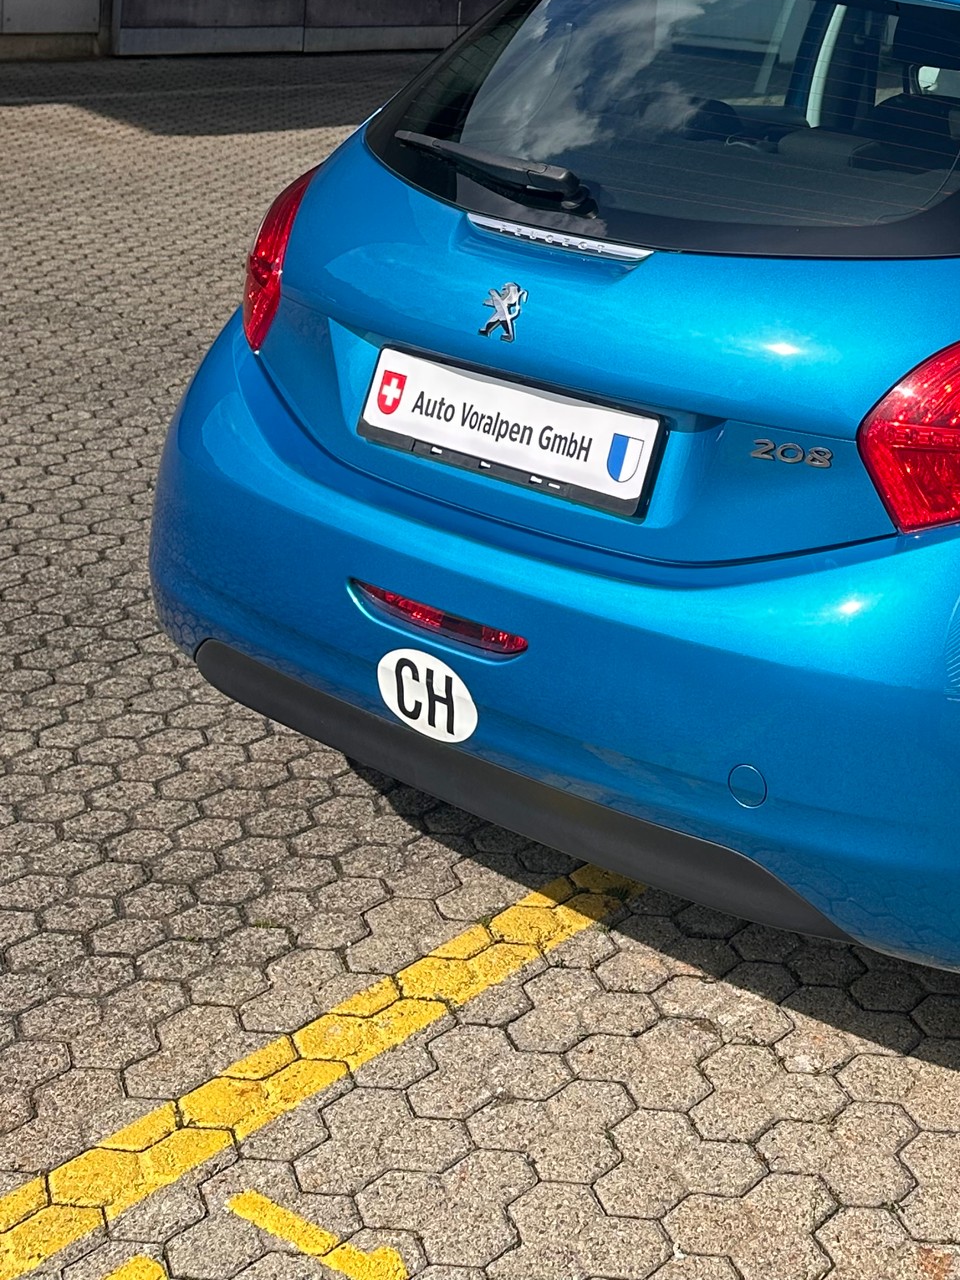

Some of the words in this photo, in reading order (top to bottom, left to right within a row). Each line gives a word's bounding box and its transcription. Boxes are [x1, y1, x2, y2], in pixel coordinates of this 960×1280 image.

[500, 223, 606, 254] PEUGEOT
[411, 391, 456, 422] Auto
[460, 402, 534, 446] Voralpen
[538, 425, 593, 462] GmbH
[750, 438, 833, 469] 208
[395, 657, 455, 735] CH
